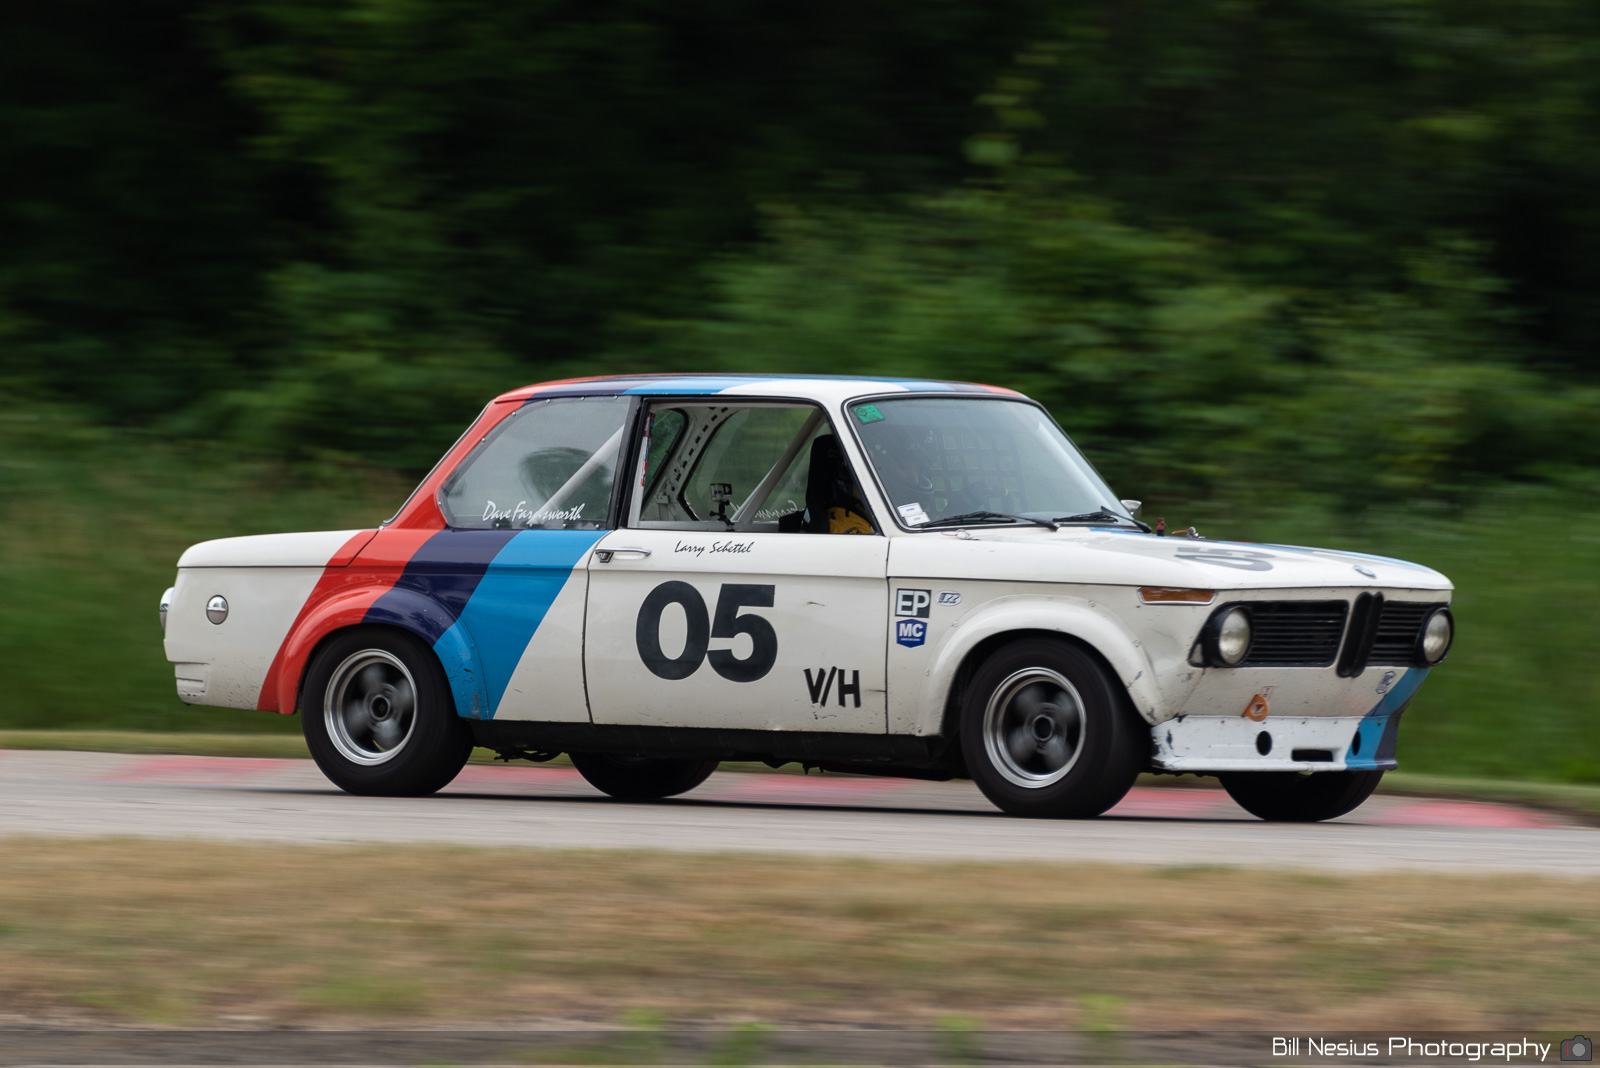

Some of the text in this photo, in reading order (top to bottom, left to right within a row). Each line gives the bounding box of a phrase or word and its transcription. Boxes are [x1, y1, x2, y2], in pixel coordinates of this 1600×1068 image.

[483, 500, 511, 521] Dave
[674, 540, 755, 557] Larry Schettel
[896, 590, 930, 616] EP
[636, 580, 778, 683] 05
[899, 623, 924, 638] MC
[803, 666, 861, 708] V/H
